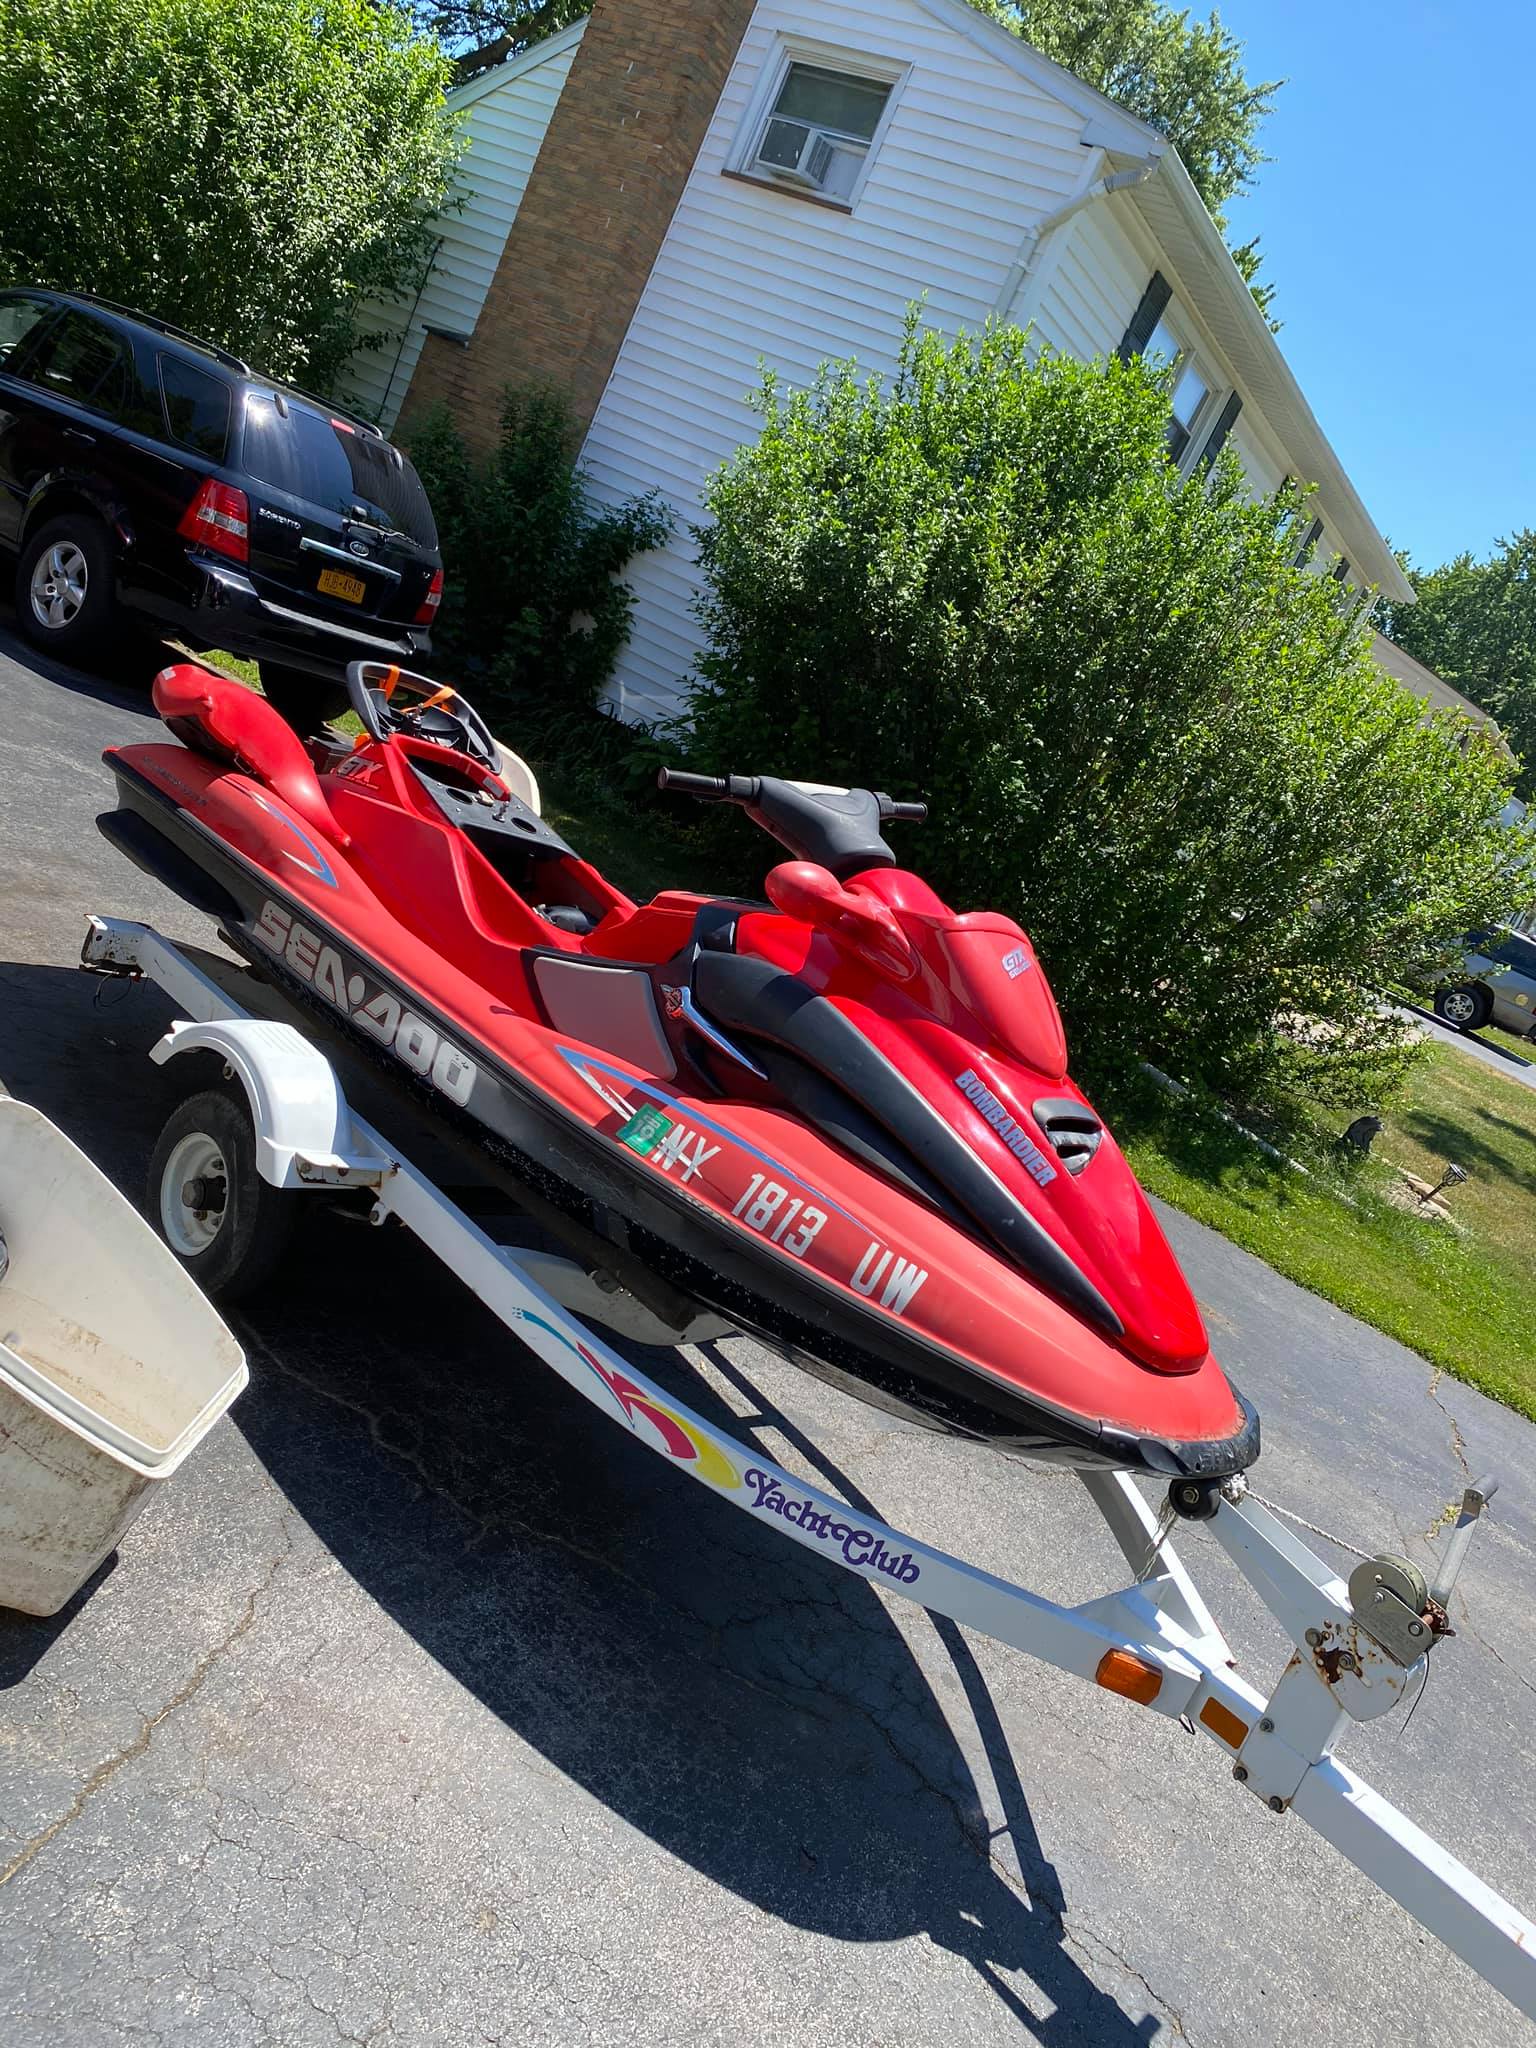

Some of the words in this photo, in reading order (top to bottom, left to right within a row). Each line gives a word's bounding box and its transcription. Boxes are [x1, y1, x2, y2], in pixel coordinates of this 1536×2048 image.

[955, 1068, 1057, 1187] BOMBARDIER
[651, 1124, 722, 1182] NY
[731, 1173, 828, 1258] 1813
[850, 1242, 929, 1315] UW
[744, 1468, 832, 1539] Yacht
[830, 1523, 920, 1584] Club
